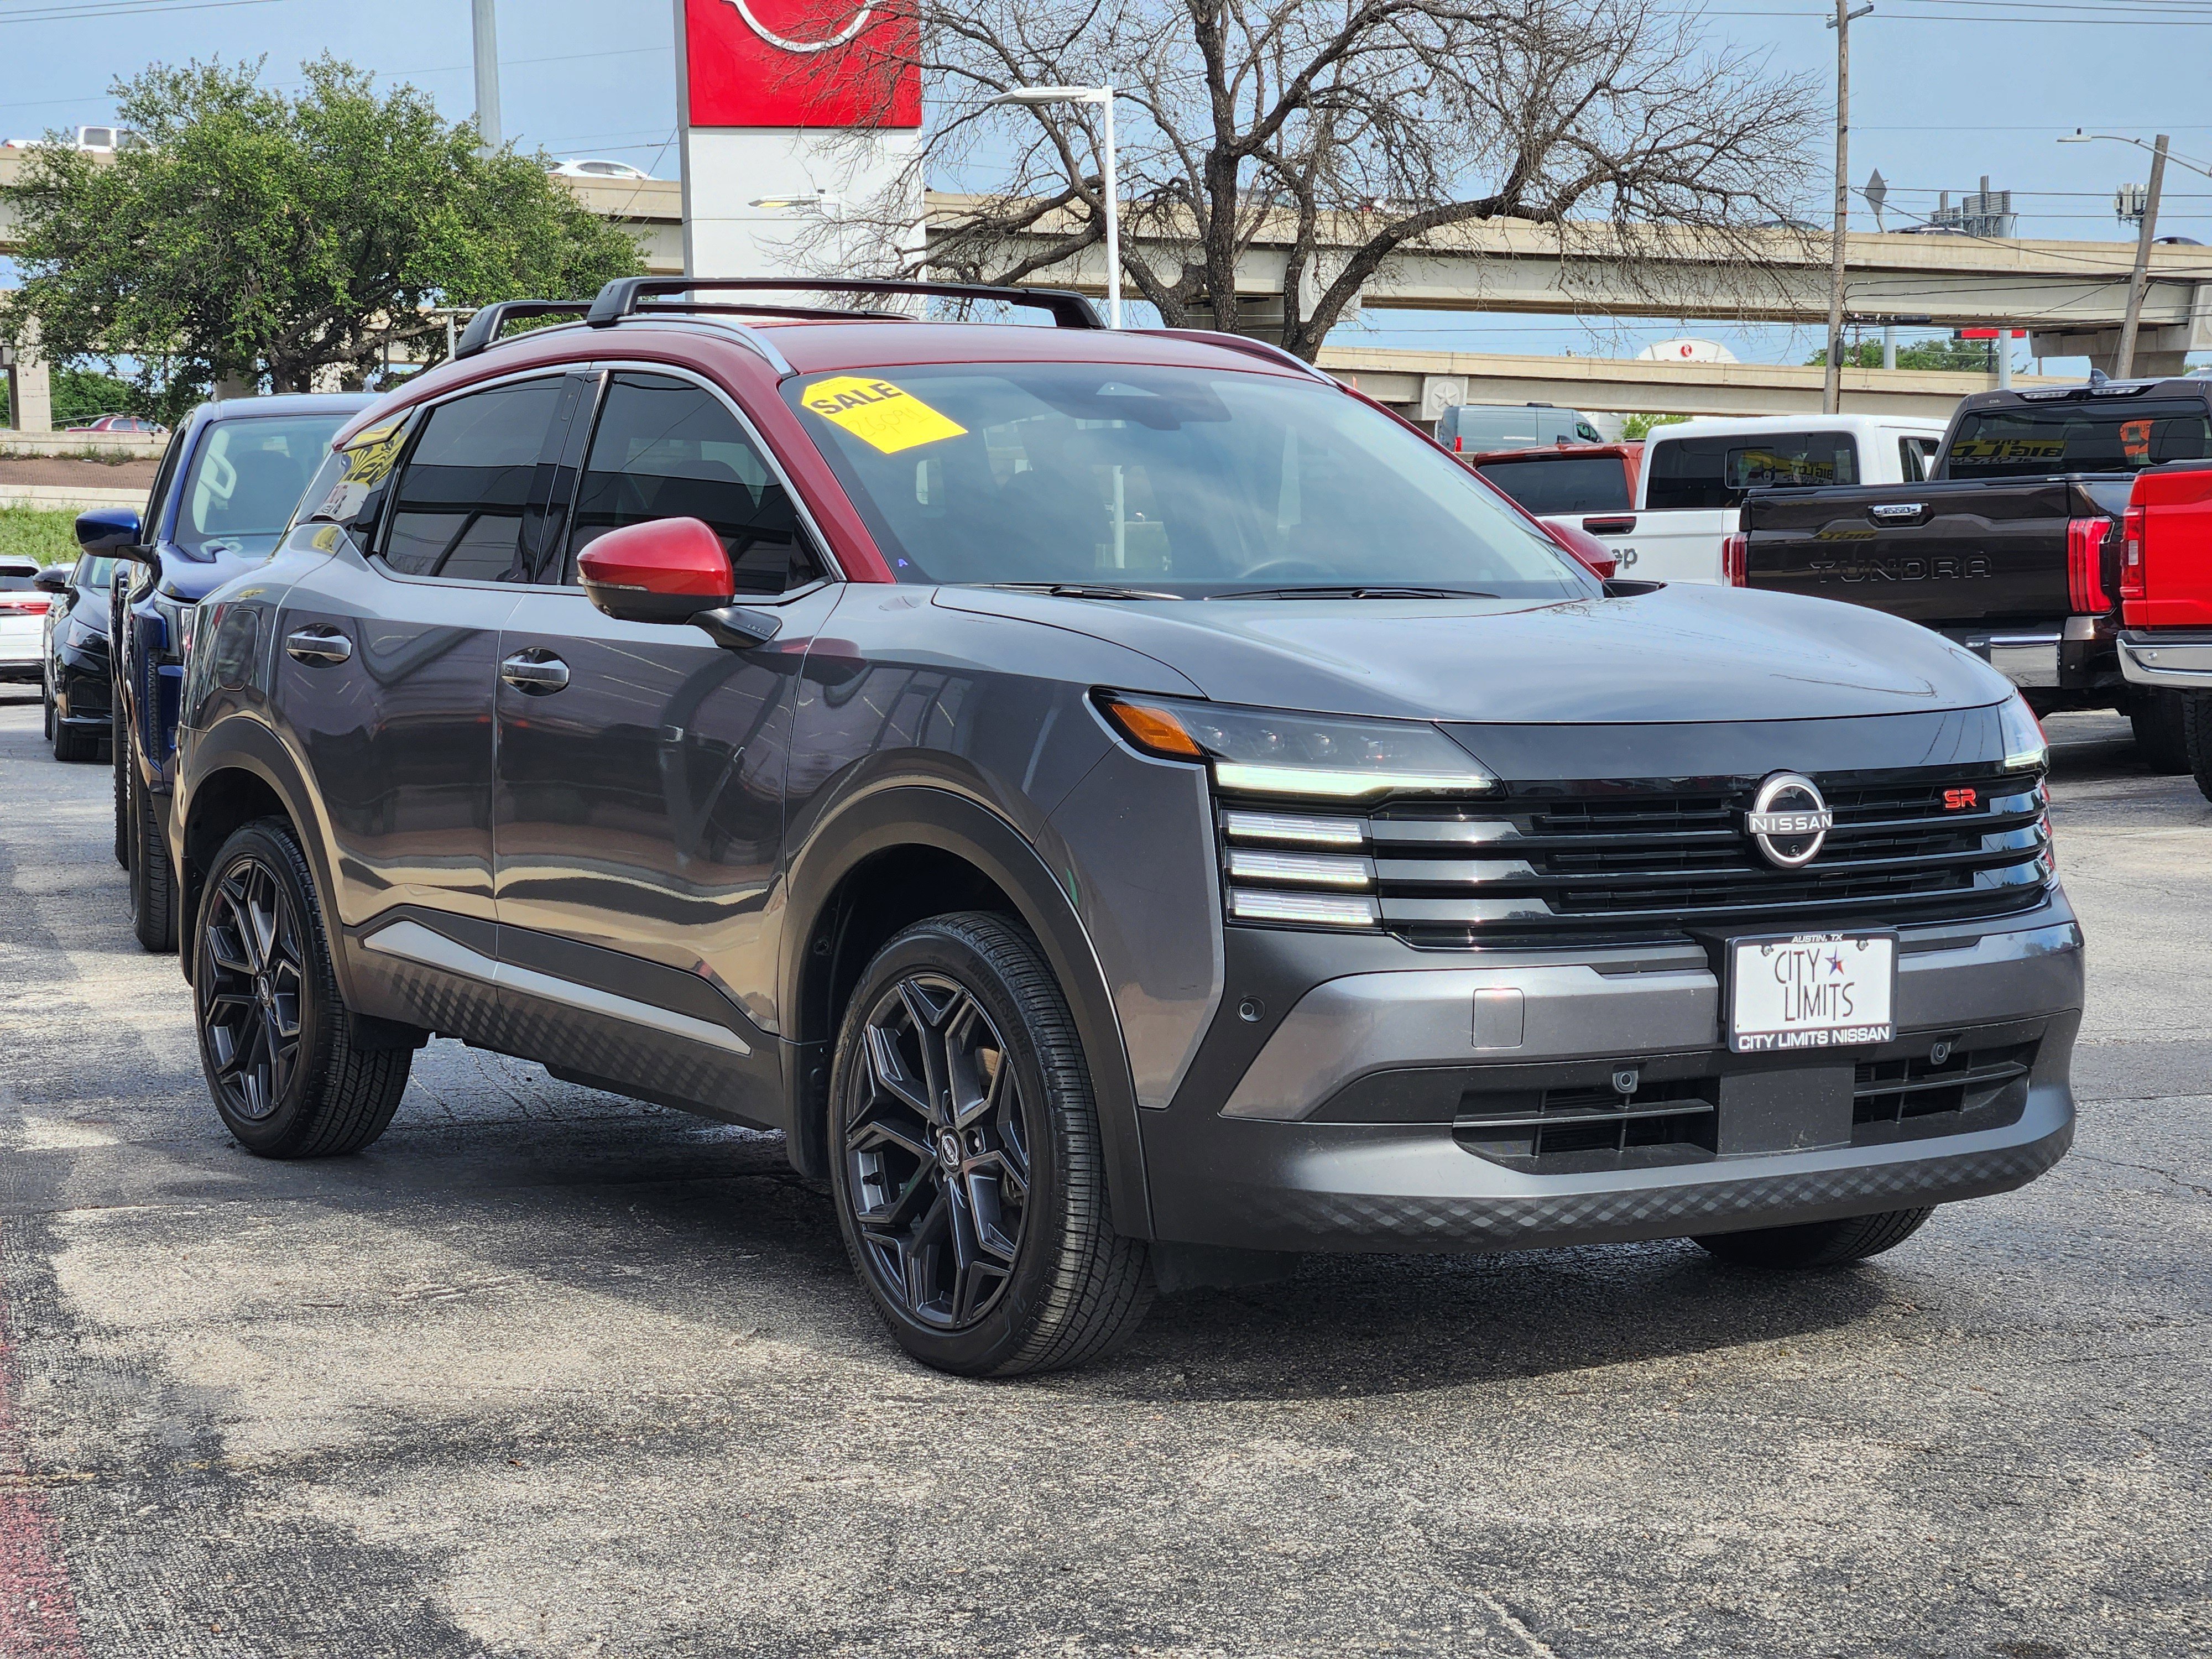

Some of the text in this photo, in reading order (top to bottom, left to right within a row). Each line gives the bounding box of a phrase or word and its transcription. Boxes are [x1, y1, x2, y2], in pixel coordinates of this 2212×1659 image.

[810, 382, 904, 414] SALE
[1611, 548, 1637, 569] ep
[1810, 555, 1991, 583] TUNDRA
[1944, 789, 1977, 809] SR
[1752, 814, 1832, 831] NISSAN
[1791, 933, 1843, 943] AUSTIN, TX
[1775, 948, 1820, 1019] CITY
[1785, 982, 1855, 1021] LIMITS
[1738, 1026, 1890, 1050] CITY LIMITS NISSAN
